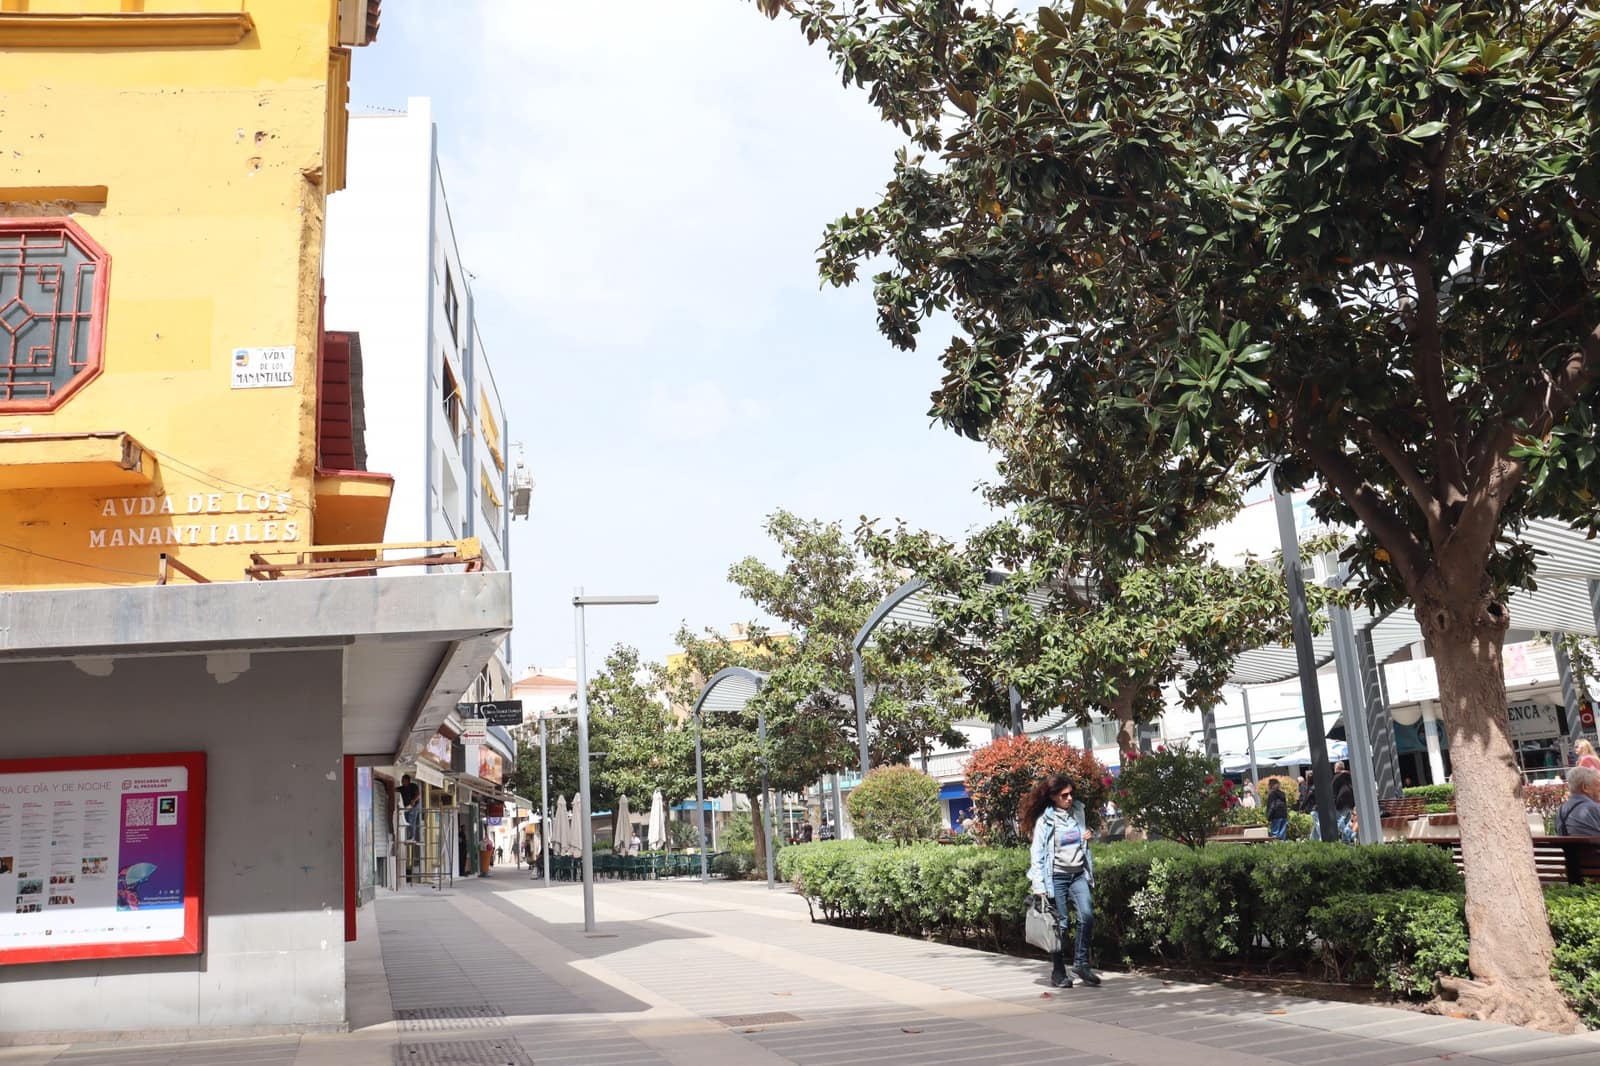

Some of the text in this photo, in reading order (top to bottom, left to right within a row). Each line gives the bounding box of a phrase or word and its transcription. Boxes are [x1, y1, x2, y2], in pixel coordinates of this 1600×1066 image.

[262, 351, 286, 360] AVDA
[272, 362, 284, 370] LOS
[236, 372, 293, 384] MANANTIALES
[102, 491, 291, 517] AVDA DE LOS
[89, 522, 298, 548] MANANTIALES
[17, 784, 31, 794] DE
[52, 783, 59, 793] Y
[62, 782, 75, 792] DE
[77, 781, 112, 792] NOCHE
